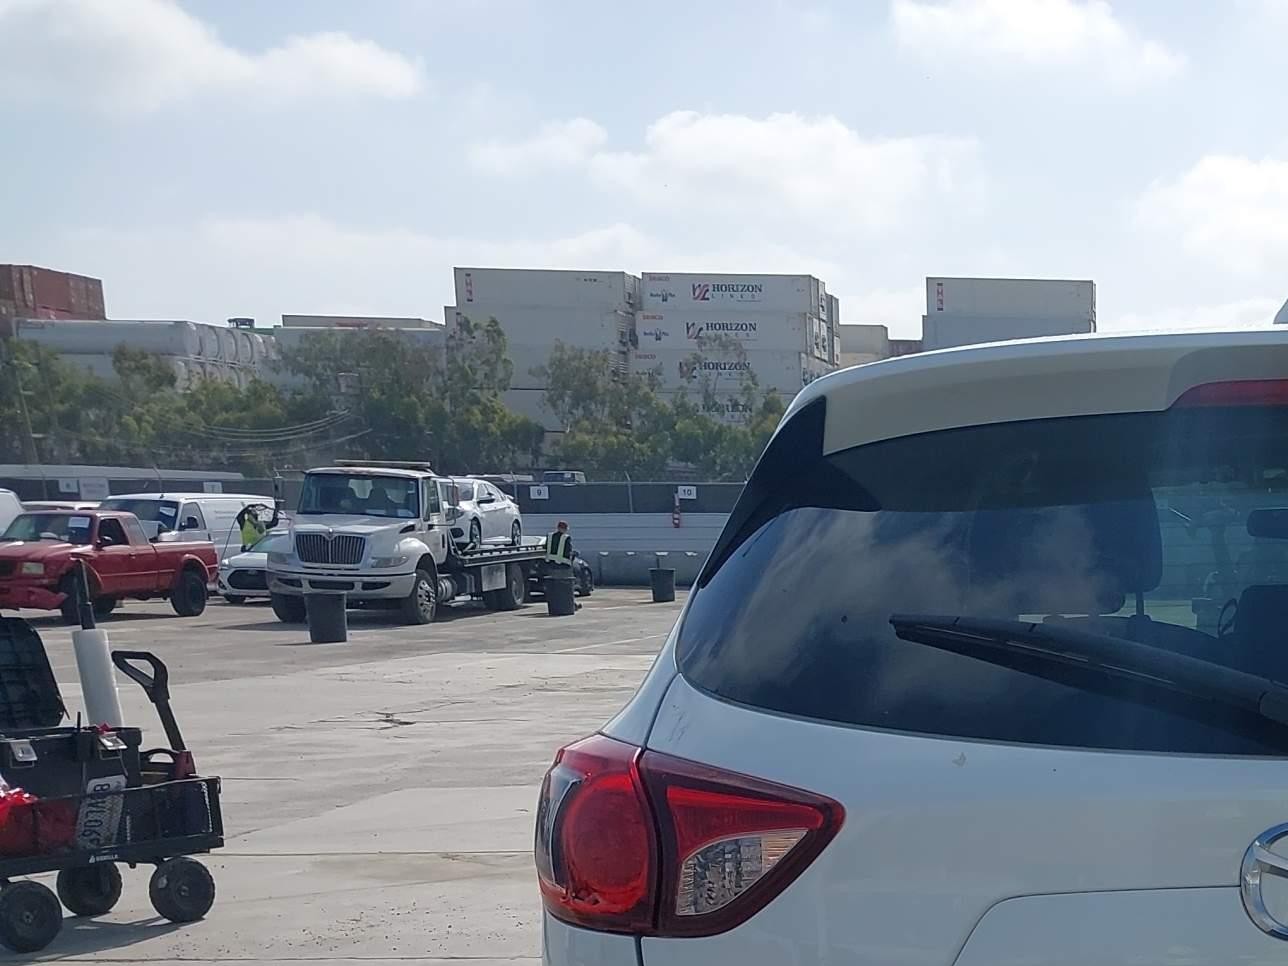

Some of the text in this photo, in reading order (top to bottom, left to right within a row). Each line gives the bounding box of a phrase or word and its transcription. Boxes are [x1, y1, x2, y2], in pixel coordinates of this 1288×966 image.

[711, 283, 763, 293] HORIZON
[705, 322, 758, 332] HORIZON
[683, 488, 692, 497] 10
